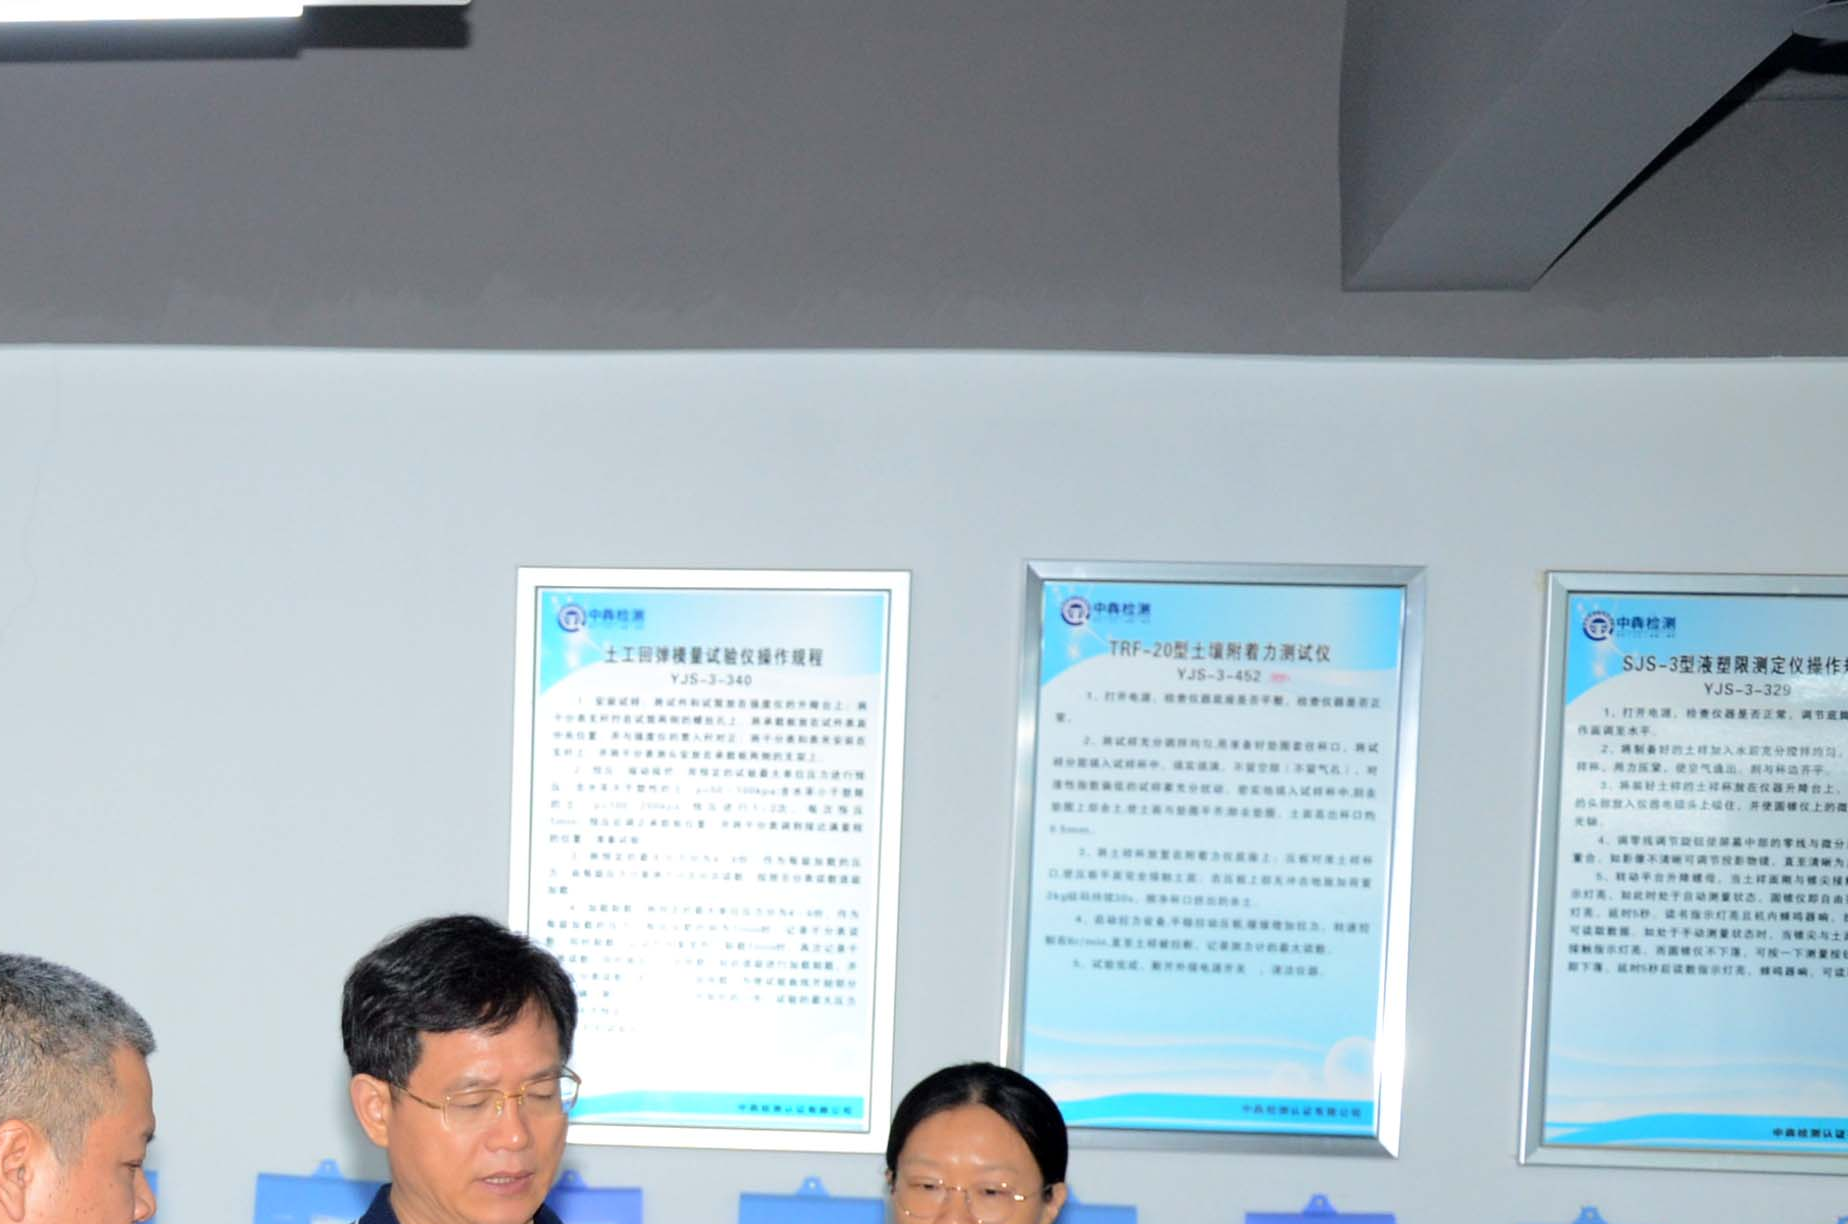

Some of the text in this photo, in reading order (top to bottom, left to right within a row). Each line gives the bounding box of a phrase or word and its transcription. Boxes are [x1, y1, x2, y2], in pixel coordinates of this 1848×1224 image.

[604, 645, 825, 668] 土工回弹模量试验仪操作规程
[1108, 640, 1331, 663] TRF-20型土壤附着力测试仪
[670, 674, 753, 686] YJS-3-340
[1177, 669, 1262, 683] YJS-3-452
[1704, 683, 1792, 697] YJS-3-329
